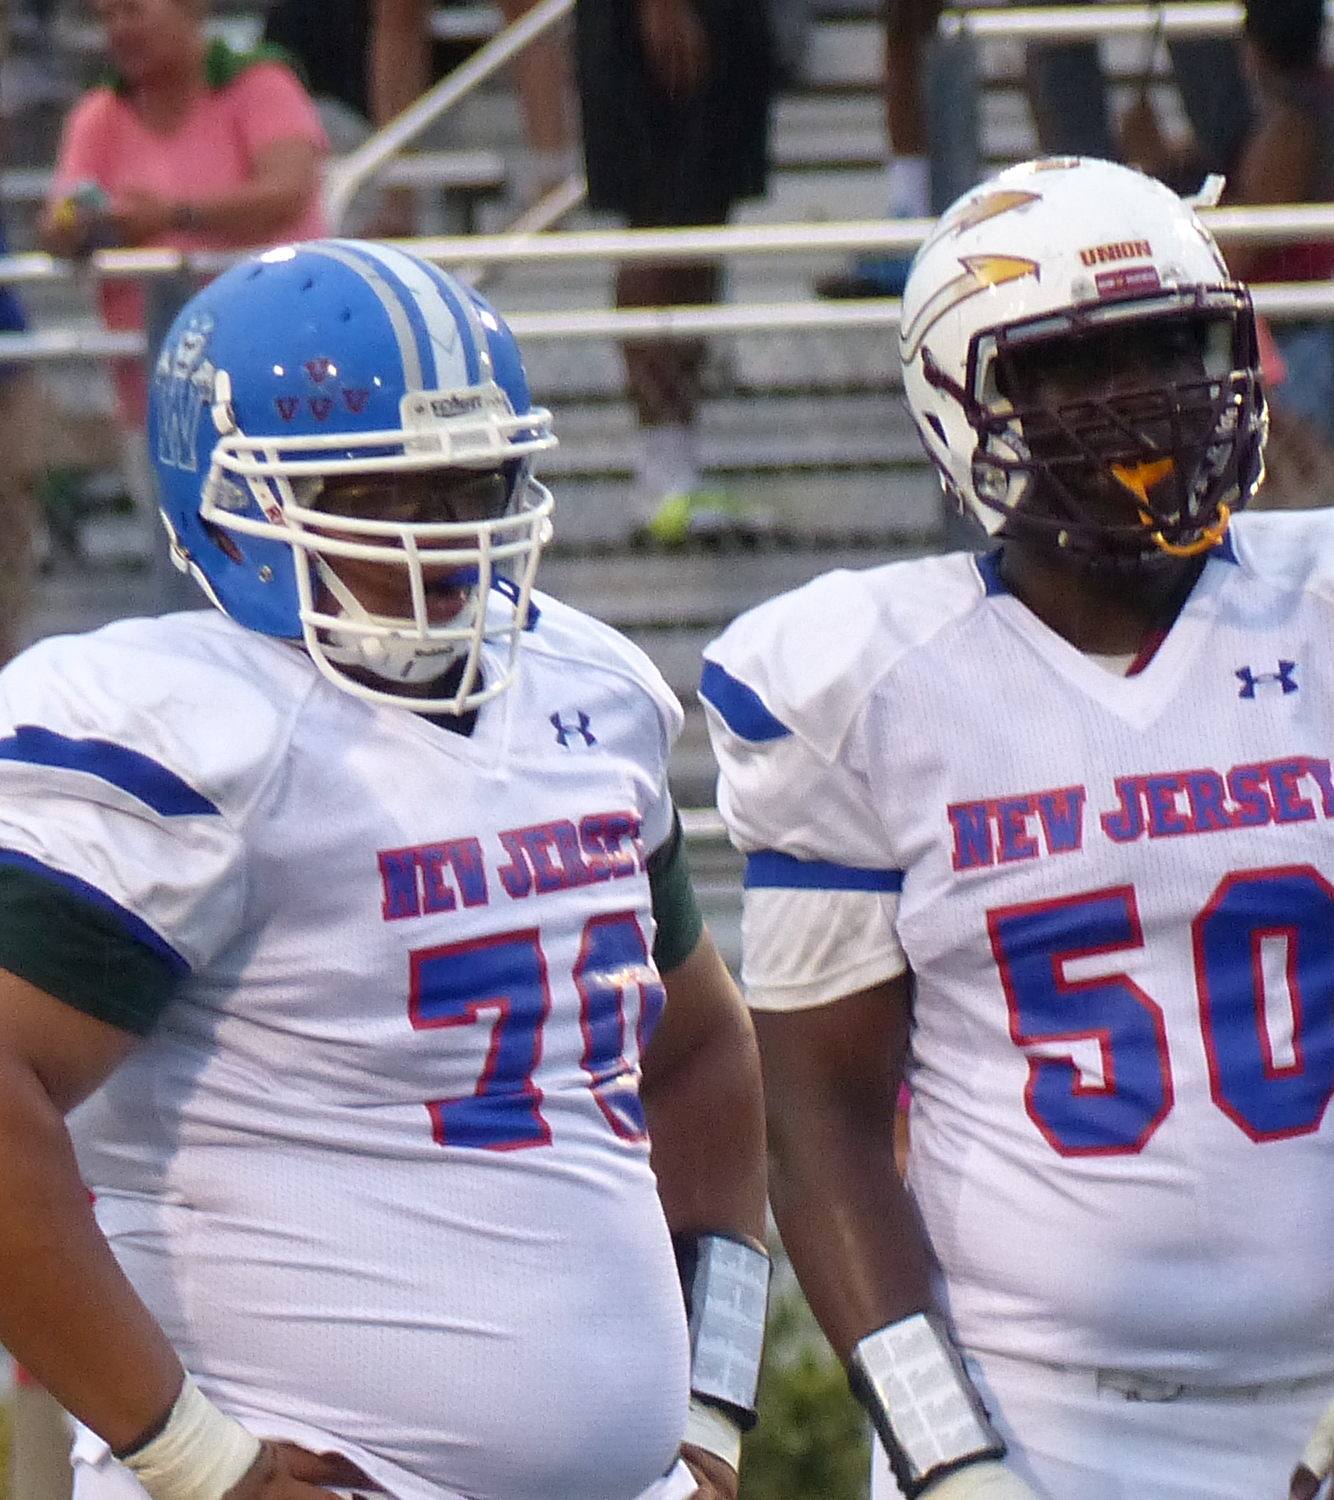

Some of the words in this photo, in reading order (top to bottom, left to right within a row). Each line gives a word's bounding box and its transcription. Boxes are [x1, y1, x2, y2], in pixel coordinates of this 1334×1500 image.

[1079, 240, 1153, 266] UNION
[947, 784, 1087, 872] NEW
[376, 836, 489, 921] NEW
[407, 910, 667, 1153] 70
